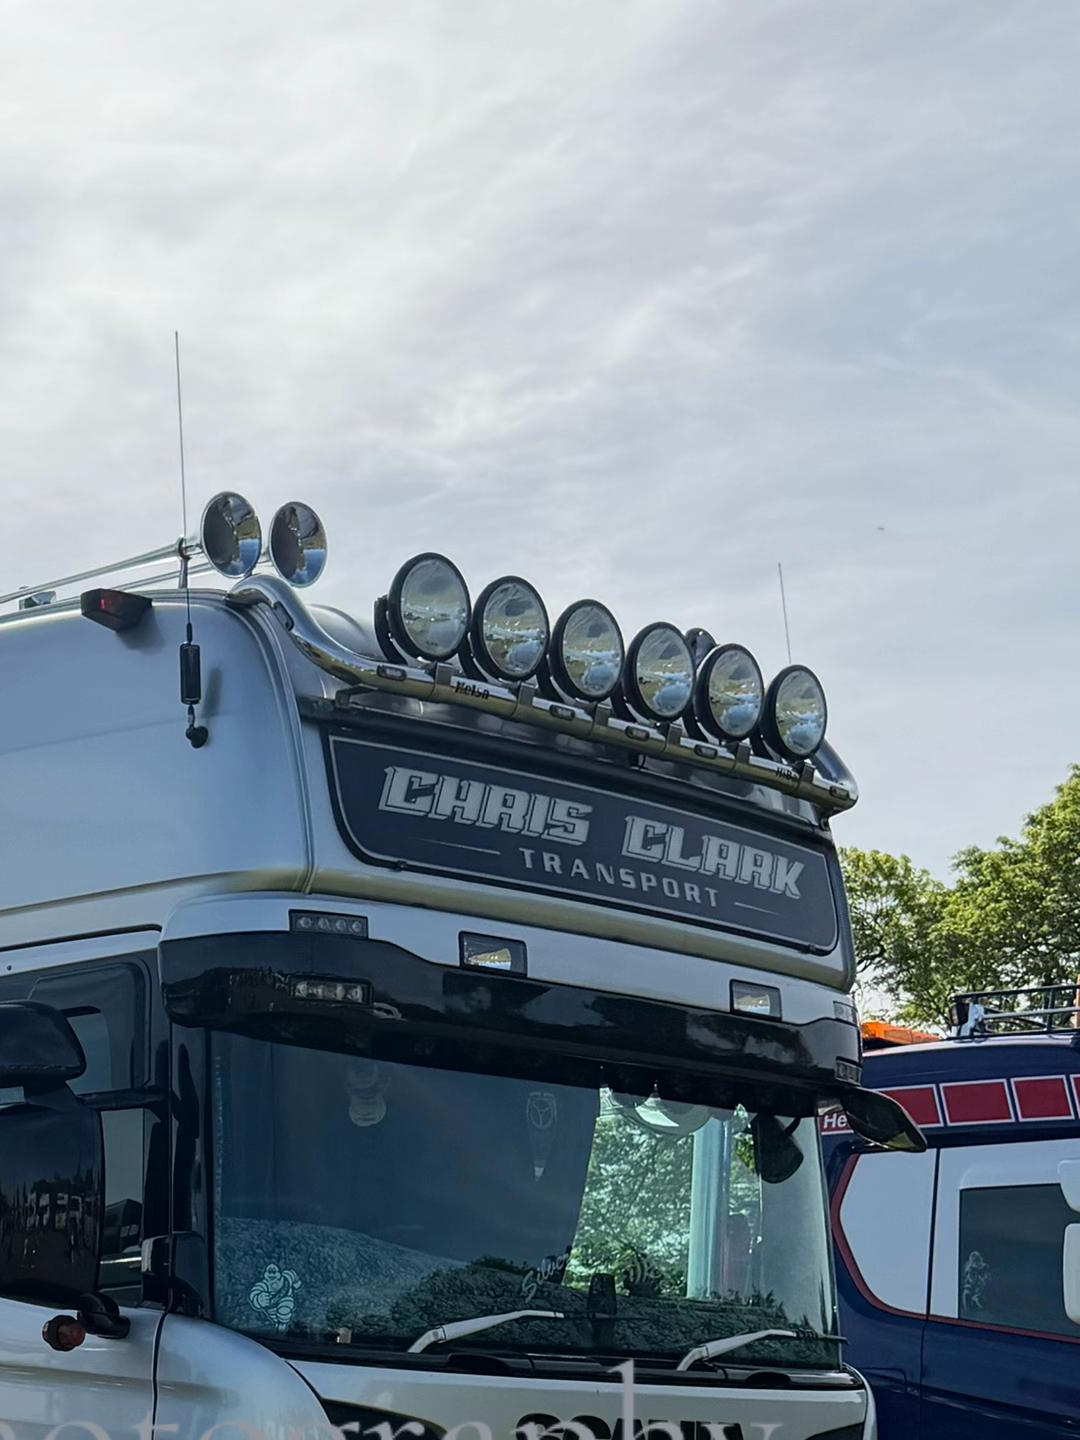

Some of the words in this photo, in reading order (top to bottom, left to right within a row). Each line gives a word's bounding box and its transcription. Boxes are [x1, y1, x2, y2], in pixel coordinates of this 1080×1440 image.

[378, 766, 593, 846] CHRIS
[621, 815, 805, 899] CLARK
[519, 848, 718, 908] TRANSPORT
